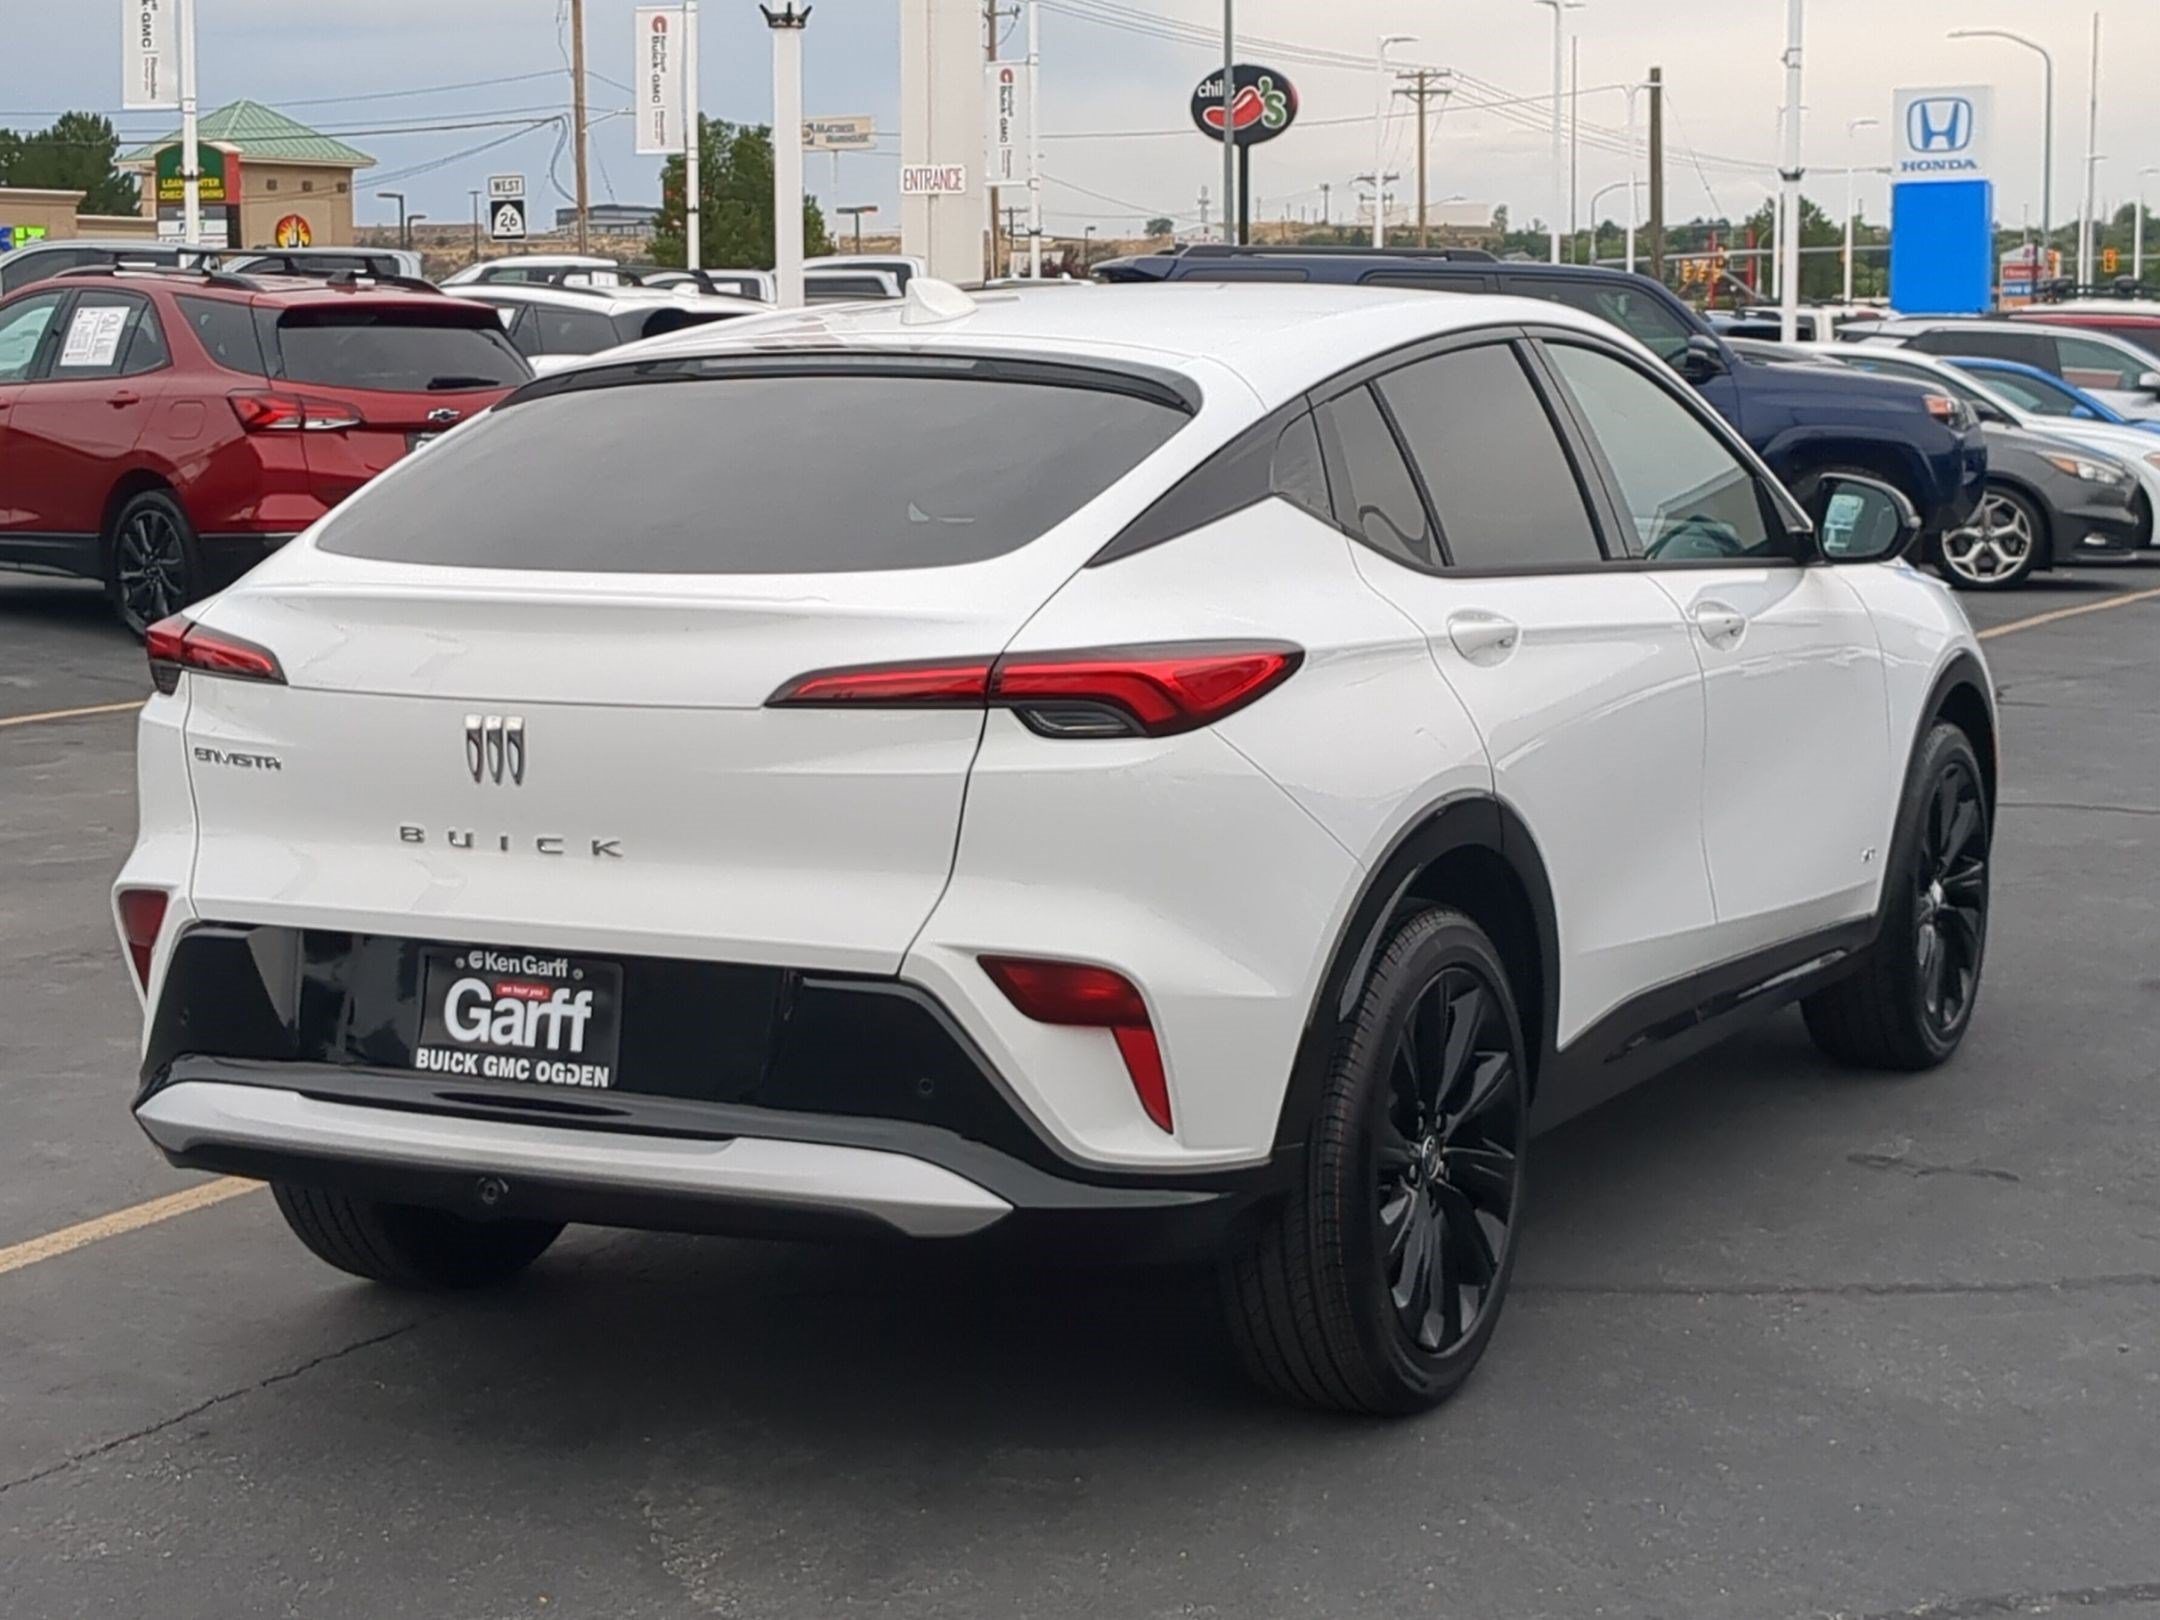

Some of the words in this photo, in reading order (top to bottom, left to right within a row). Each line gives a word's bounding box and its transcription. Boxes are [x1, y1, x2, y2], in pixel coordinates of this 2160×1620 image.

[141, 12, 152, 48] GMC
[651, 73, 661, 103] GMC
[1901, 159, 1977, 172] HONDA
[494, 180, 519, 192] WEST
[903, 168, 962, 192] ENTRANCE
[500, 212, 518, 227] 26
[400, 826, 622, 858] BUICK
[485, 952, 520, 974] Ken
[522, 955, 568, 978] Garff
[444, 977, 593, 1053] Garff
[415, 1048, 478, 1075] BUICK
[483, 1055, 530, 1080] GMC
[535, 1061, 609, 1088] OGDEN
